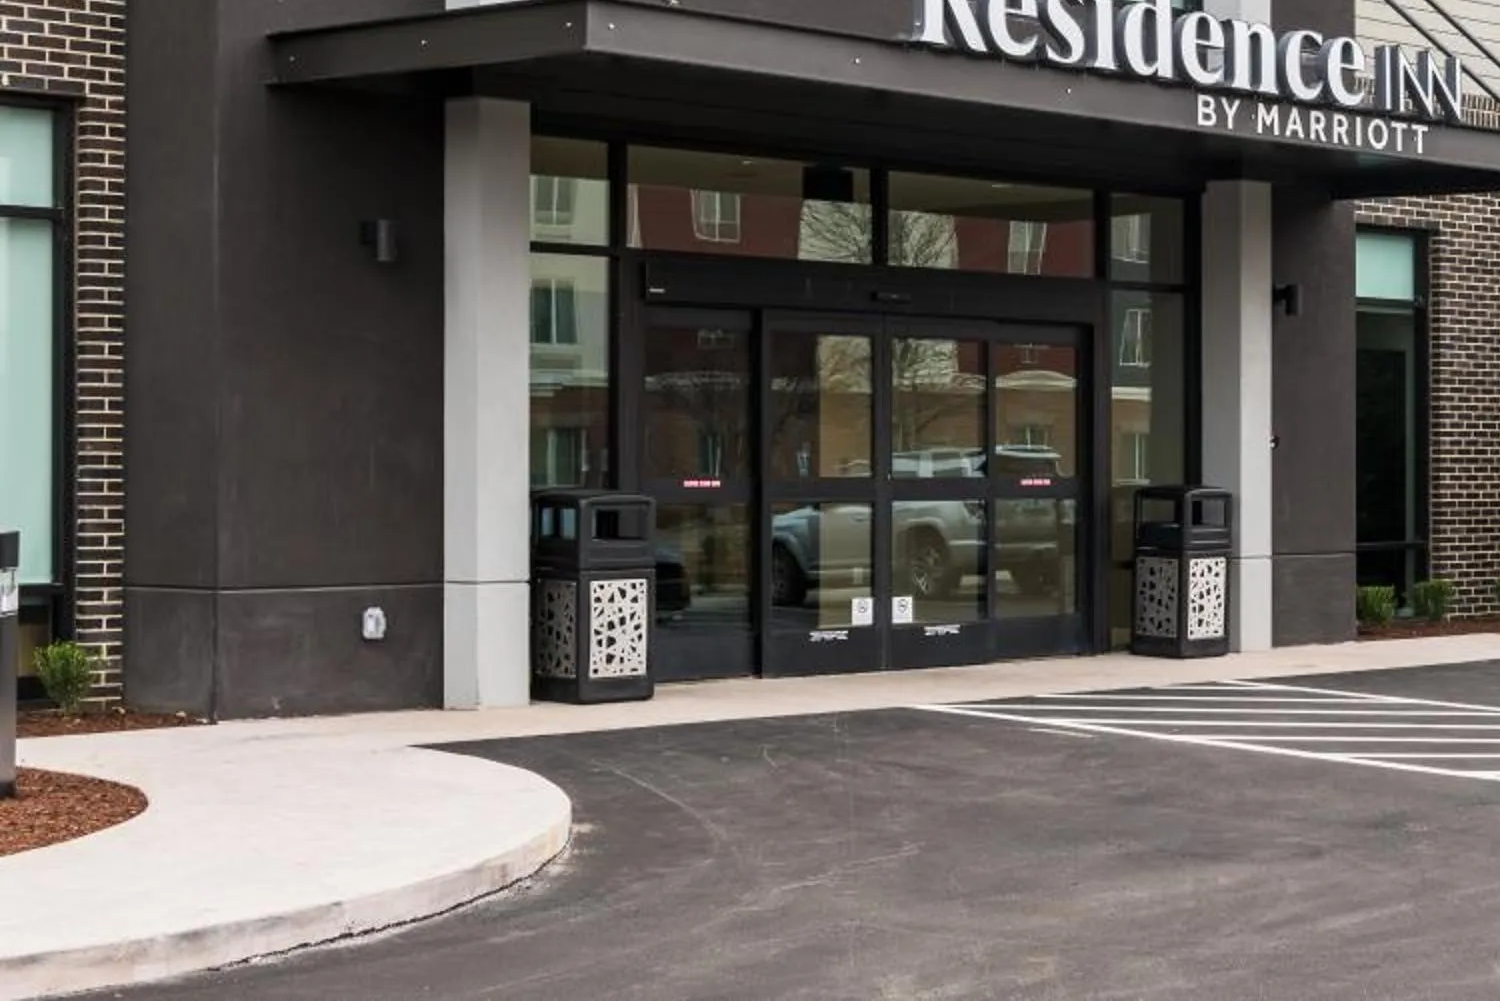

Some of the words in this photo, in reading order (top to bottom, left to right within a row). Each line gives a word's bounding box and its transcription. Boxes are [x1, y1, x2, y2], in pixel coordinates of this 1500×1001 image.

[1378, 44, 1462, 120] INN
[1197, 94, 1240, 130] BY
[1256, 102, 1429, 154] MARRIOTT
